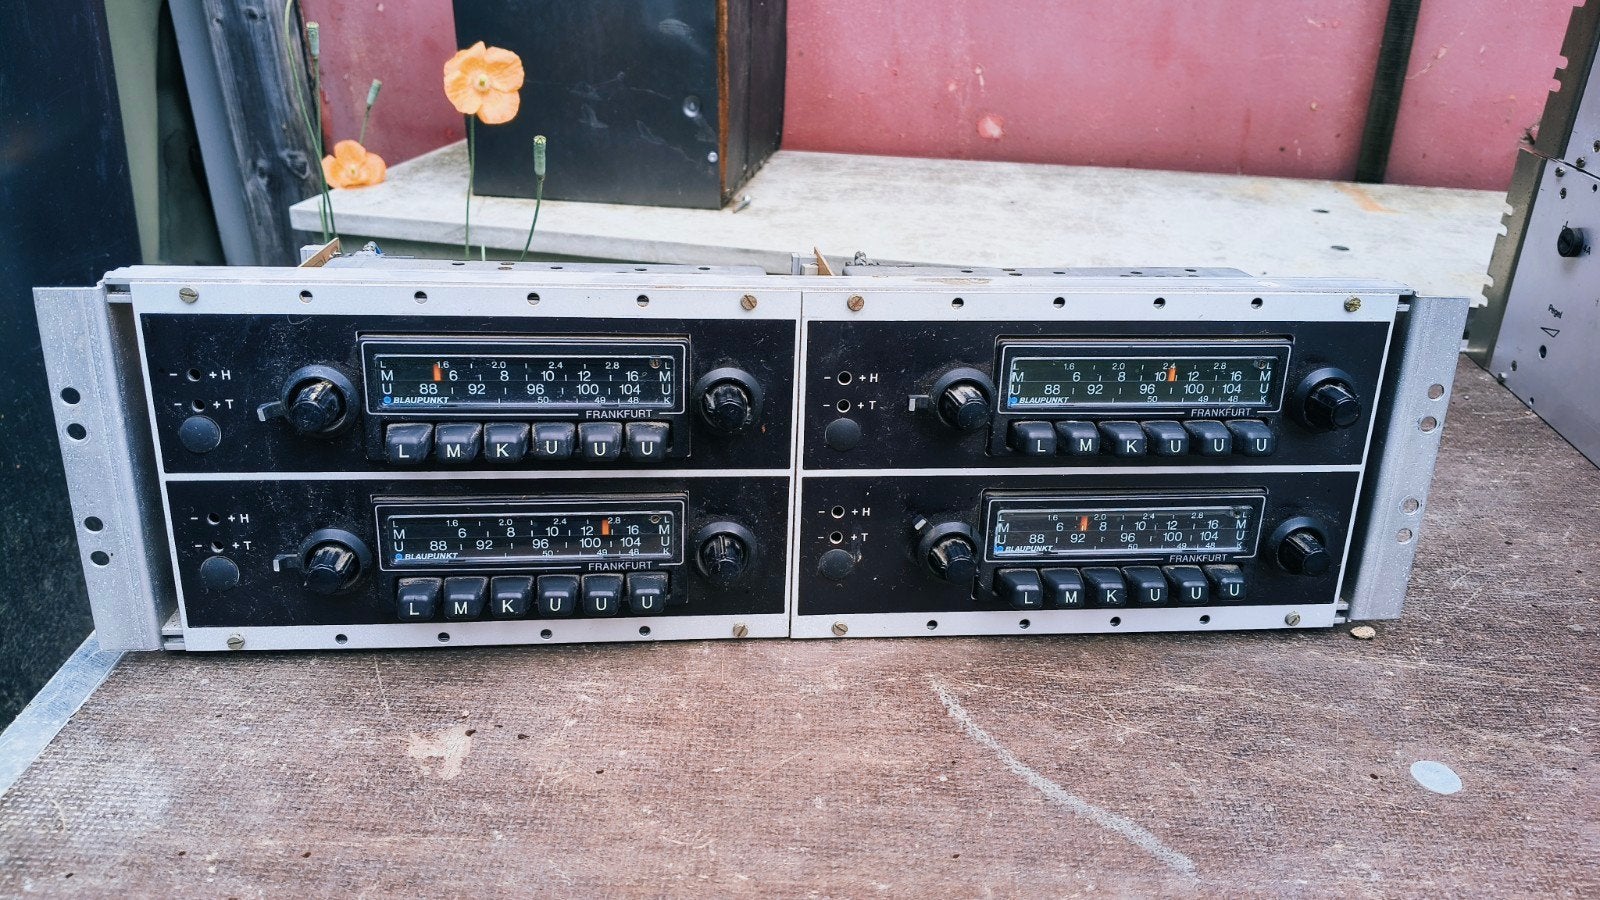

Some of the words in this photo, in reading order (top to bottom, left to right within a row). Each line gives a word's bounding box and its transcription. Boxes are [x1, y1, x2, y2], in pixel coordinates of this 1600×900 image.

[1112, 362, 1125, 370] 2.0
[381, 370, 393, 381] M
[449, 370, 458, 381] 6
[500, 370, 509, 381] 8
[541, 371, 555, 382] 10
[578, 371, 591, 382] 12
[626, 371, 639, 382] 16
[659, 371, 671, 382] M
[1012, 372, 1024, 382] M
[1072, 371, 1081, 382] 6
[1117, 371, 1126, 382] 8
[1155, 371, 1167, 382] 10
[1188, 371, 1200, 381] 12
[1230, 371, 1242, 381] 16
[1260, 371, 1271, 381] M
[382, 383, 392, 395] U
[419, 383, 438, 395] 88
[468, 383, 486, 395] 92
[527, 383, 545, 395] 96
[576, 384, 599, 395] 100
[619, 384, 641, 395] 104
[661, 384, 671, 395] U
[1011, 385, 1021, 395] U
[1044, 384, 1060, 395] 88
[1087, 384, 1103, 395] 92
[1139, 384, 1156, 394] 96
[1184, 384, 1204, 394] 100
[1222, 384, 1242, 394] 104
[1260, 383, 1269, 394] U
[1260, 395, 1267, 403] K
[586, 410, 652, 419] FRANKFURT
[1191, 408, 1252, 417] FRANKFURT
[398, 444, 410, 458] L
[446, 444, 461, 458] M
[496, 443, 509, 457] K
[546, 440, 559, 454] U
[594, 442, 606, 456] U
[641, 441, 654, 455] U
[1037, 439, 1046, 452] L
[1080, 439, 1092, 451] M
[1127, 440, 1137, 453] K
[1171, 440, 1181, 453] U
[1214, 439, 1224, 451] U
[1256, 439, 1267, 451] U
[393, 520, 399, 528] L
[998, 523, 1010, 533] M
[1056, 522, 1064, 531] 6
[1099, 522, 1107, 531] 8
[1135, 521, 1147, 531] 10
[1167, 521, 1178, 530] 12
[1207, 520, 1219, 530] 16
[1236, 520, 1247, 529] M
[393, 529, 405, 540] M
[458, 528, 467, 538] 6
[507, 527, 515, 538] 8
[546, 526, 559, 537] 10
[581, 526, 594, 536] 12
[626, 525, 639, 535] 16
[659, 525, 670, 535] M
[997, 535, 1007, 544] U
[1029, 534, 1045, 544] 88
[1070, 533, 1086, 543] 92
[1120, 533, 1136, 542] 96
[1163, 532, 1182, 541] 100
[1200, 531, 1219, 541] 104
[1236, 531, 1245, 540] U
[394, 541, 404, 551] U
[430, 541, 448, 551] 88
[476, 540, 494, 550] 92
[532, 539, 549, 549] 96
[580, 538, 601, 548] 100
[620, 537, 642, 548] 104
[661, 537, 670, 546] U
[628, 548, 639, 556] 48
[1170, 554, 1228, 562] FRANKFURT
[588, 561, 653, 571] FRANKFURT
[1024, 593, 1033, 604] L
[1066, 591, 1077, 603] M
[1107, 590, 1117, 602] K
[1151, 589, 1161, 601] U
[1192, 588, 1202, 600] U
[1230, 584, 1240, 596] U
[409, 603, 420, 616] L
[454, 602, 468, 615] M
[502, 600, 514, 613] K
[550, 598, 561, 612] U
[596, 598, 607, 611] U
[642, 596, 653, 609] U
